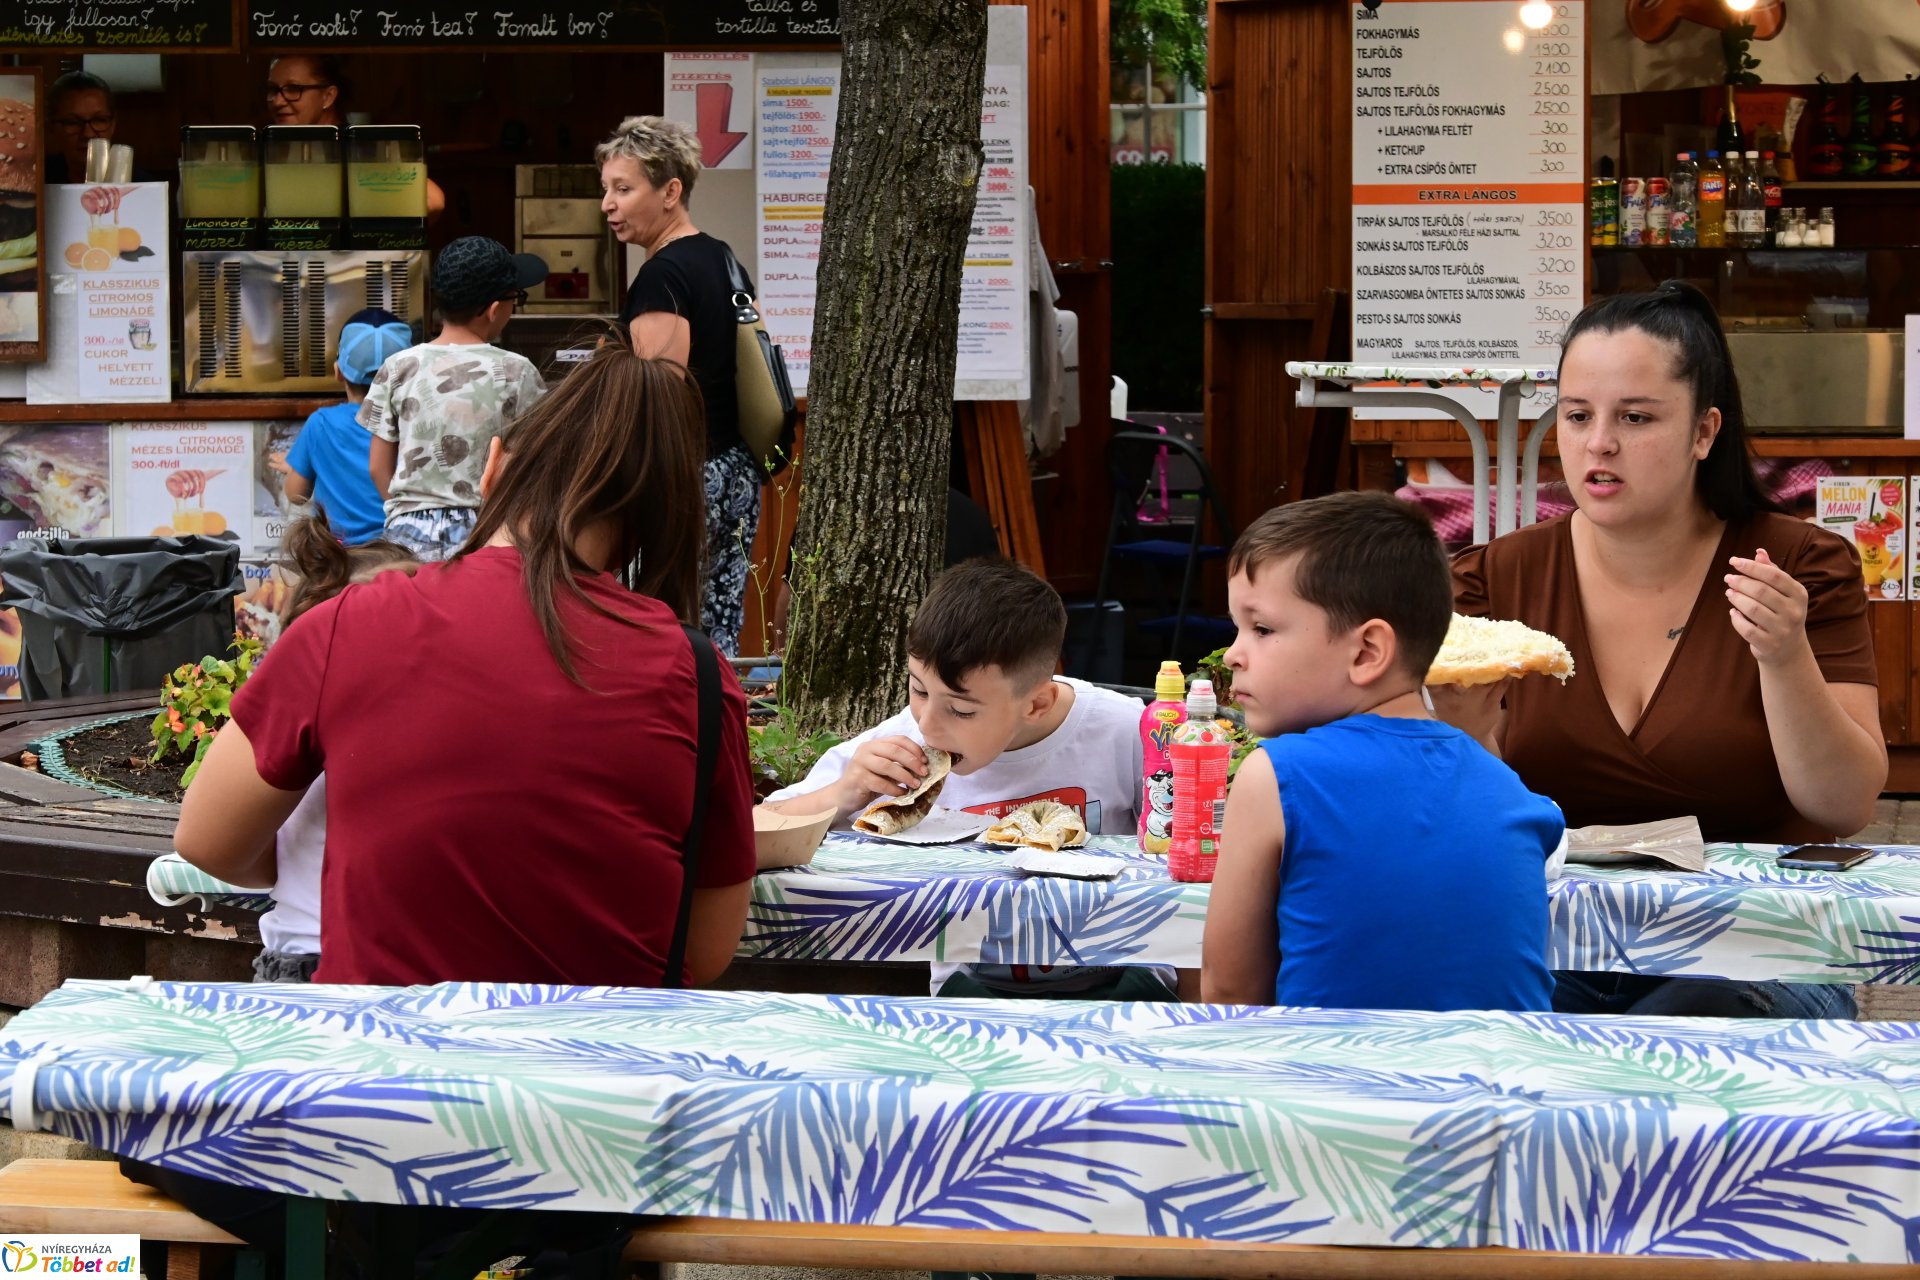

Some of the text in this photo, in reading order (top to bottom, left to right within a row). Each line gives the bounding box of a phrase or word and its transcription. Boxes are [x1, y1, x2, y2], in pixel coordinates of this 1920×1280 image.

[1356, 9, 1379, 20] SIMA
[1356, 26, 1420, 39] FOKHAGYMÁS
[1356, 43, 1570, 59] TEJFÖLÖS 1900
[1356, 61, 1571, 78] SAJTOS 2100
[801, 75, 836, 86] LÁNGOS
[1356, 81, 1570, 98] SAJTOS TEJFÖLÖS 2500
[786, 98, 814, 107] 1500.-
[1356, 101, 1570, 117] SAJTOS TEJFÖLÖS FOKHAGYMÁS 2500
[799, 111, 827, 120] 1900.-
[791, 124, 819, 133] 2100.-
[1384, 126, 1440, 137] LILAHAGYMA
[1442, 123, 1473, 136] FELTÉT
[1541, 120, 1569, 135] 300
[1384, 145, 1425, 156] KETCHUP
[1541, 139, 1567, 154] 300
[1384, 165, 1413, 175] EXTRA
[1448, 162, 1477, 174] ÖNTET
[1540, 159, 1565, 173] 300
[1418, 189, 1461, 200] EXTRA
[1356, 214, 1387, 228] TIRPÁK
[1388, 215, 1420, 227] SAJTOS
[1422, 213, 1465, 227] TEJFÖLÖS
[1537, 210, 1573, 226] 3500
[763, 225, 789, 233] SIMA
[1492, 228, 1521, 237] SAJTTAL
[763, 237, 799, 245] DUPLA
[1356, 231, 1573, 252] SONKÁS SAJTOS TEJFÖLÖS 3200
[763, 251, 790, 259] SIMA
[1356, 257, 1576, 277] KOLBÁSZOS SAJTOS TEJFÖLÖS 3200
[764, 273, 799, 281] DUPLA
[1466, 275, 1521, 286] LILAHAGYMÁVAL
[83, 279, 160, 289] KLASSZIKUS
[1356, 279, 1570, 301] SZARVASGOMBA ÖNTETES SAJTOS SONKÁS 3500
[88, 293, 154, 303] CITROMOS
[89, 306, 155, 317] LIMONÁDÉ
[1356, 305, 1571, 325] PESTO-S SAJTOS SONKÁS 3500
[1356, 338, 1403, 350] MAGYAROS
[84, 349, 129, 359] CUKOR
[1440, 350, 1461, 360] EXTRA
[98, 362, 154, 373] HELYETT
[179, 435, 245, 446] CITROMOS
[131, 443, 245, 456] MÉZES LIMONÁDÉ!
[1821, 487, 1867, 502] MELON
[1826, 502, 1862, 516] MANIA
[17, 526, 70, 541] godzilla
[244, 564, 272, 579] box
[984, 806, 1001, 816] THE
